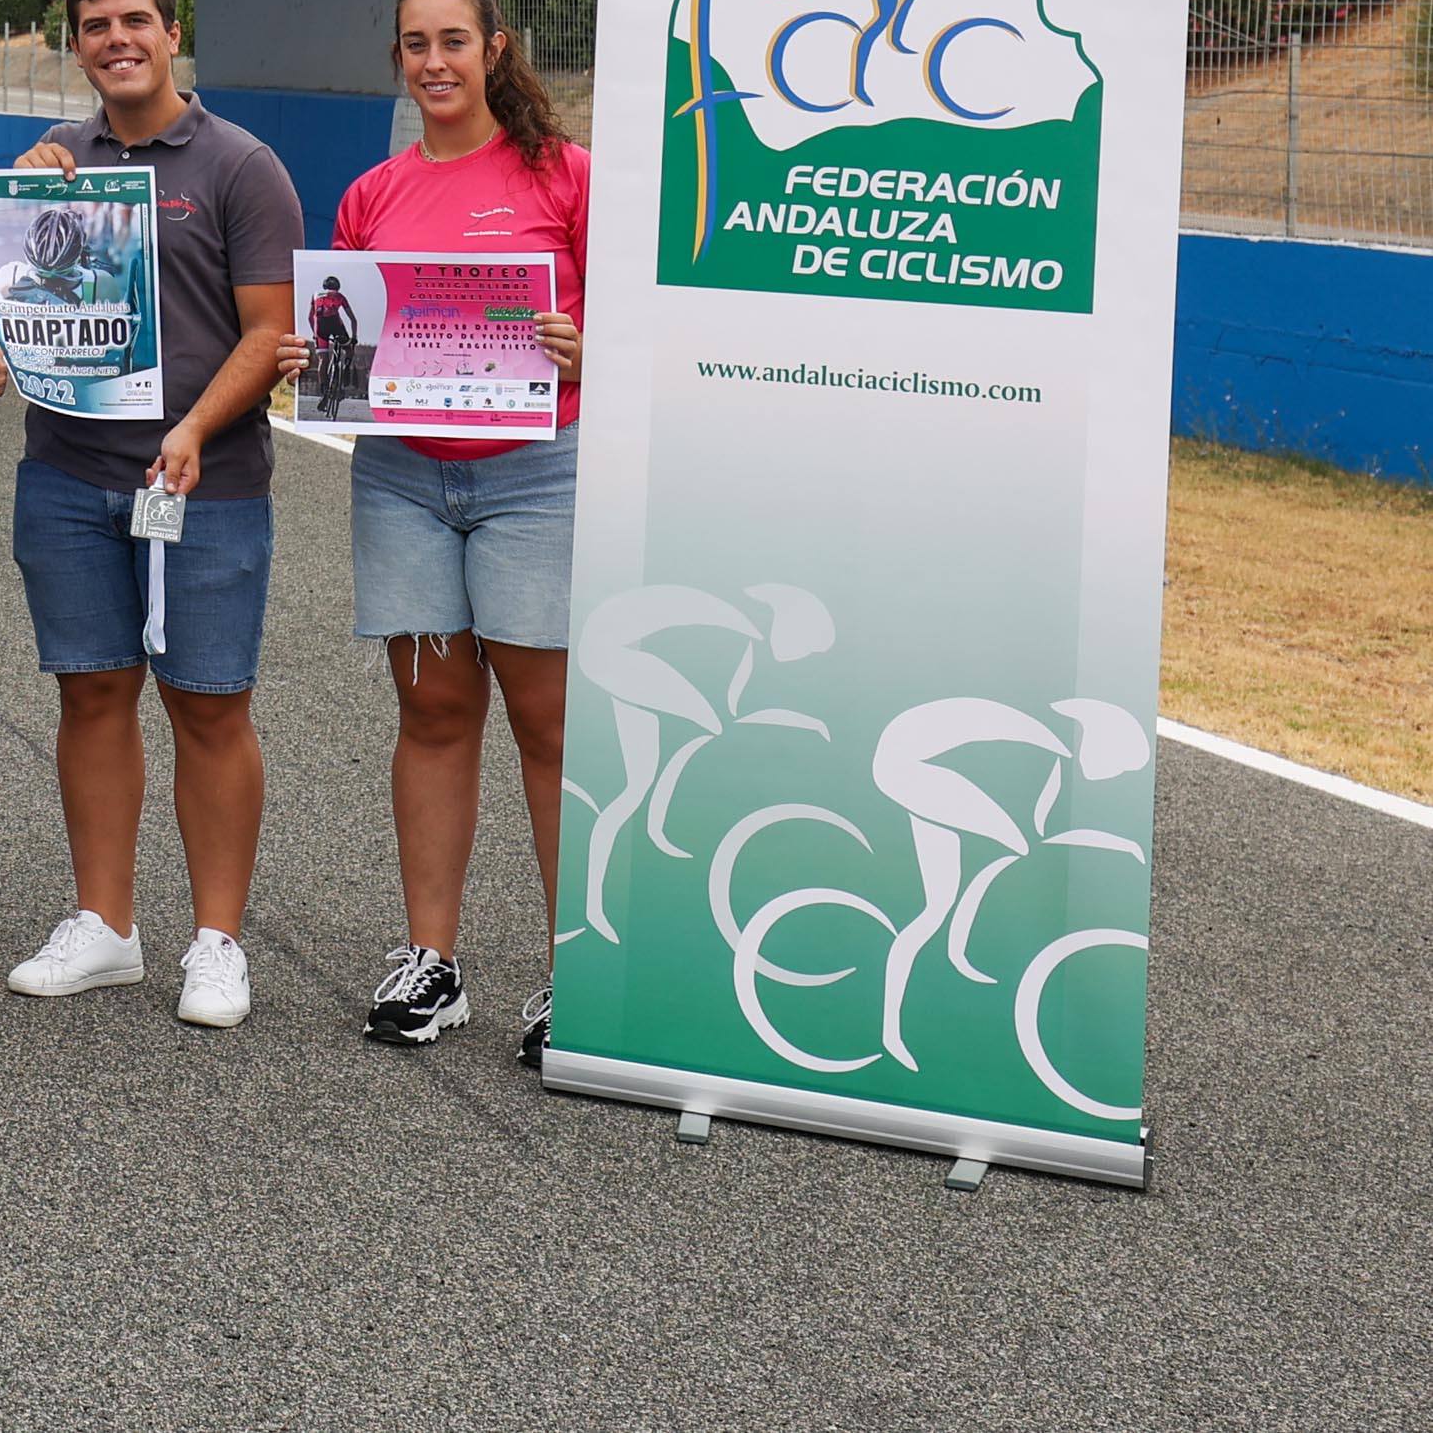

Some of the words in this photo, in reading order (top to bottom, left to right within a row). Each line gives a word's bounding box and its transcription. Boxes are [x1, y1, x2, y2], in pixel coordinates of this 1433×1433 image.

[783, 164, 1063, 211] FEDERACIÓN
[721, 200, 959, 245] ANDALUZA
[414, 266, 422, 276] V
[438, 266, 528, 278] TROFEO
[791, 243, 850, 277] DE
[859, 248, 1065, 293] CICLISMO
[78, 300, 131, 314] Andalucía
[1, 317, 128, 346] ADAPTADO
[496, 324, 533, 332] AGOST
[393, 331, 453, 340] CIRCUITO
[482, 333, 534, 341] VELOCID
[33, 347, 106, 356] CONTRARRELOJ
[501, 343, 537, 351] NIETO
[96, 366, 119, 375] NIETO
[17, 370, 77, 405] 2022
[696, 359, 1044, 404] www.andaluciaciclismo.com
